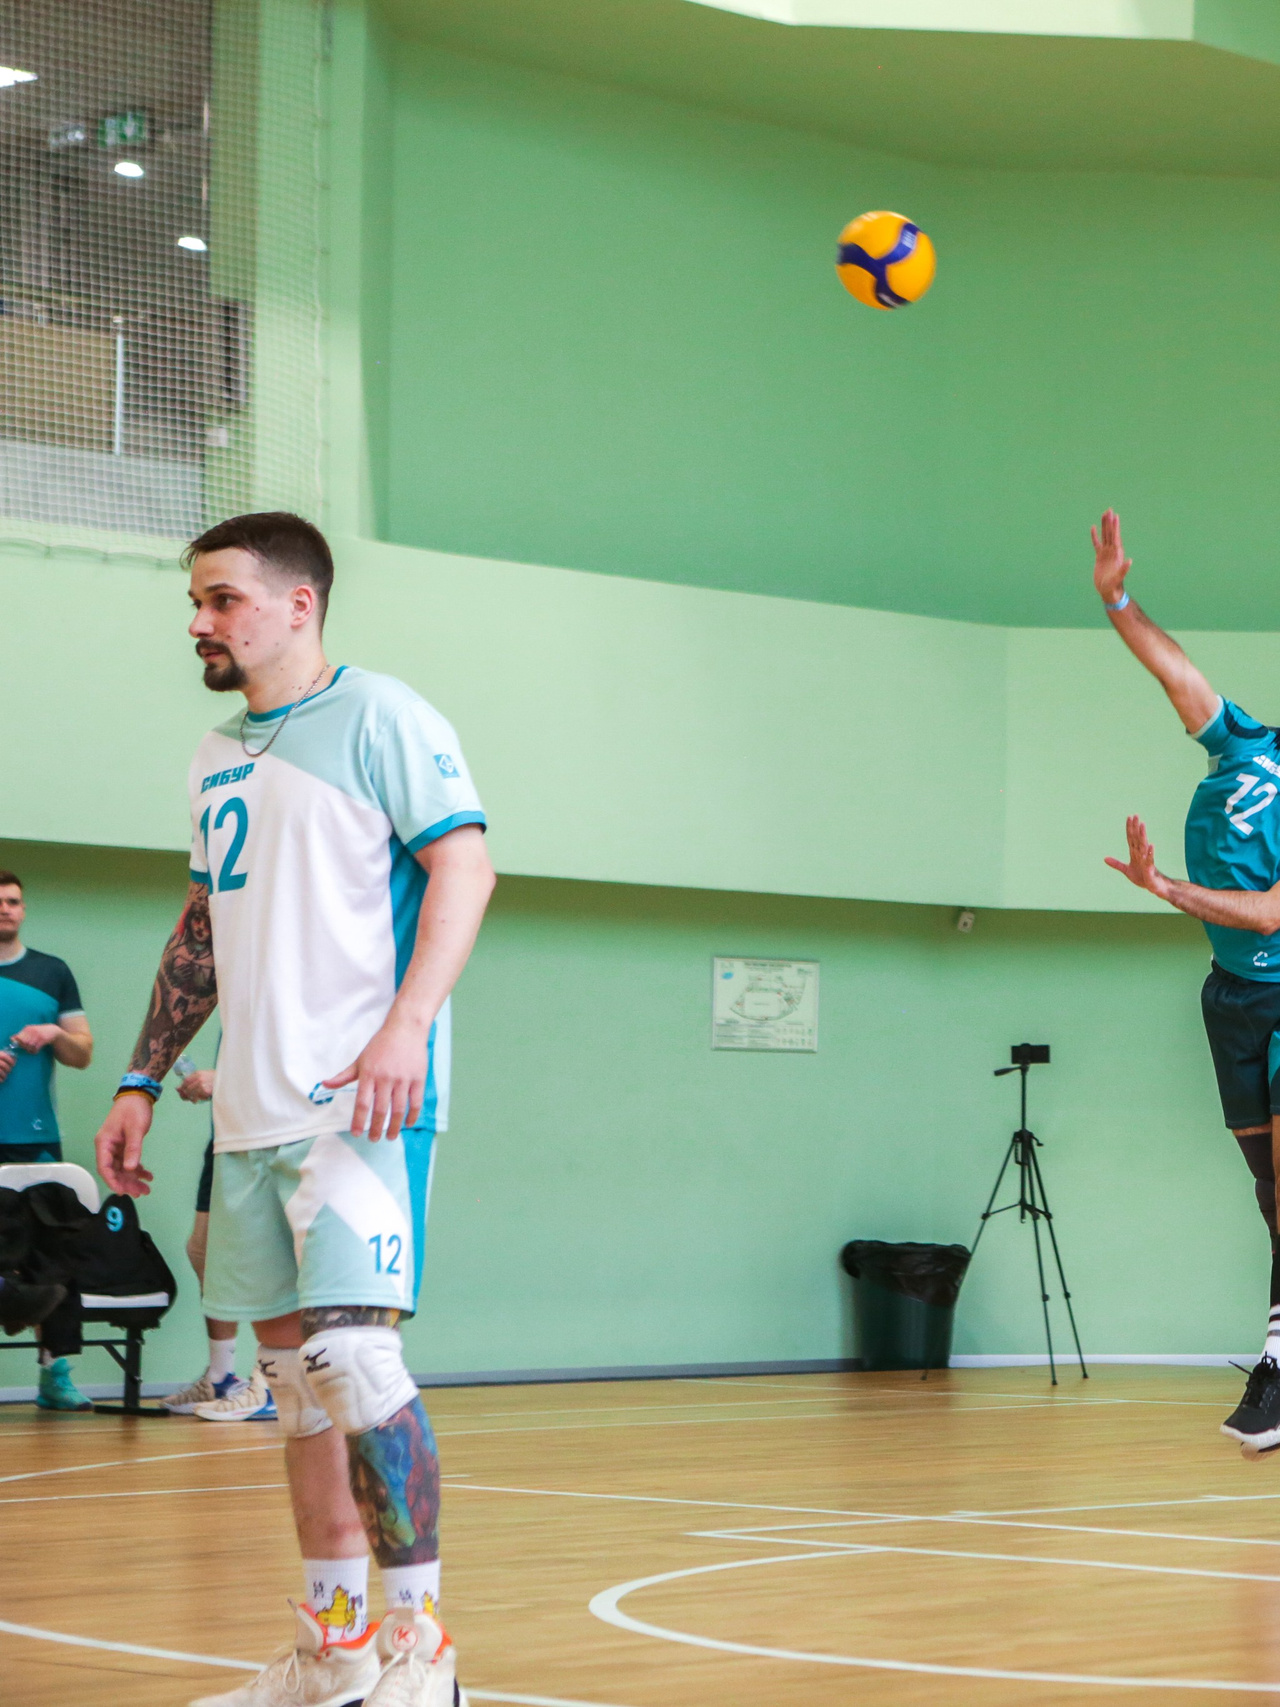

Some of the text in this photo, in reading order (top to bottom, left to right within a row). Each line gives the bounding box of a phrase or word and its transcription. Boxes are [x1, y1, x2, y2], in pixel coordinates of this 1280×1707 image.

[200, 762, 255, 794] СИБУР
[1224, 772, 1278, 836] 12
[199, 796, 249, 896] 12
[106, 1206, 123, 1232] 9
[368, 1233, 402, 1275] 12
